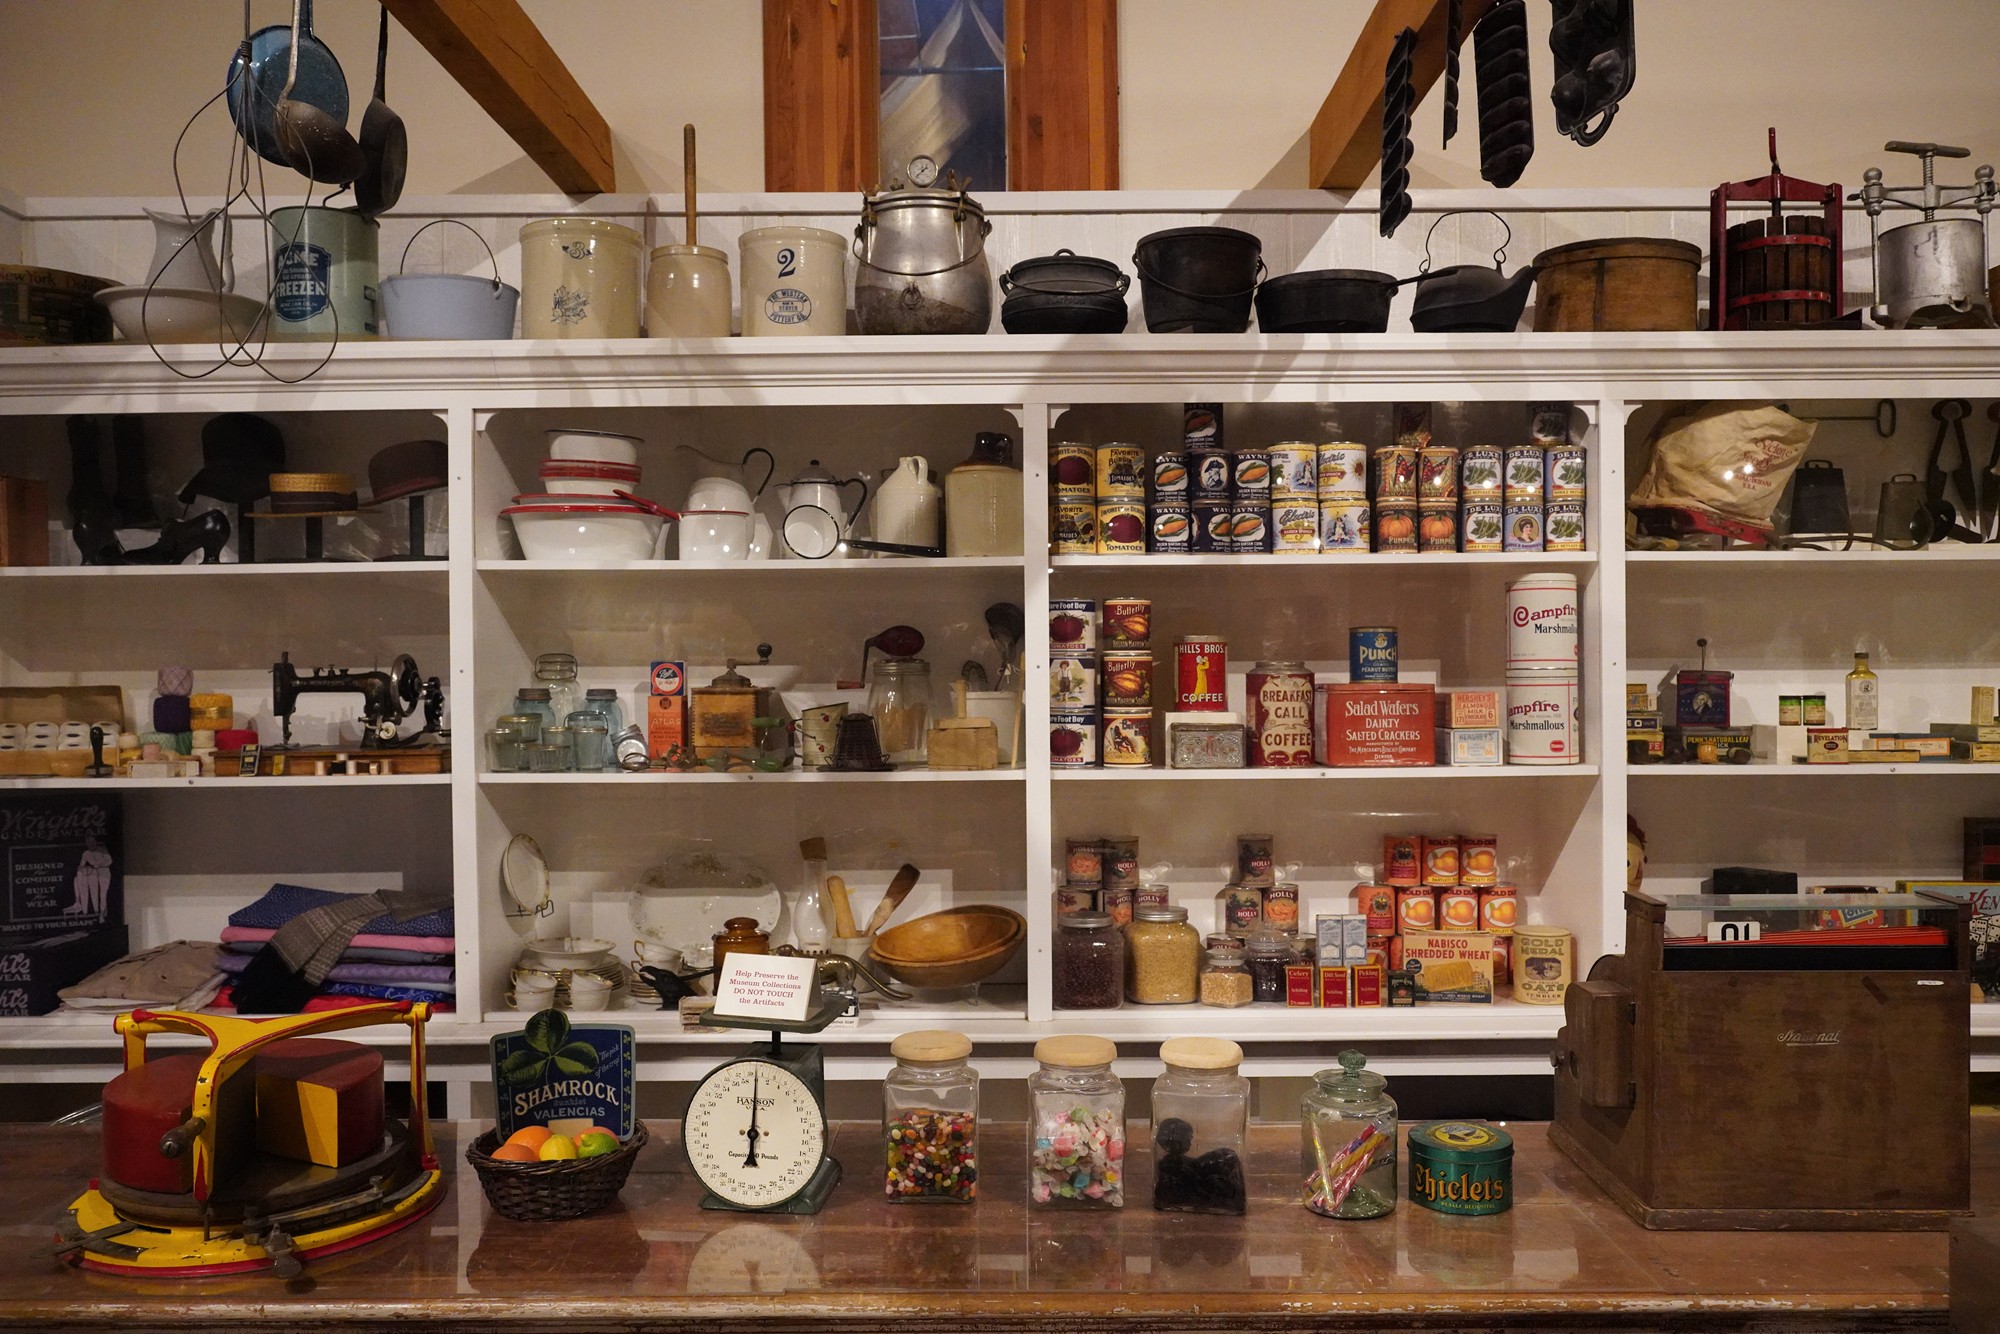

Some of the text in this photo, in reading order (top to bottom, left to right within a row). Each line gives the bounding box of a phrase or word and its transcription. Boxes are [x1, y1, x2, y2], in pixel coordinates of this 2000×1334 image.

[570, 241, 585, 259] 3
[777, 248, 797, 279] 2
[276, 281, 326, 298] FREEZER
[1557, 451, 1570, 459] DE
[1507, 506, 1520, 514] DE
[1279, 509, 1315, 526] Electric
[1106, 543, 1143, 552] TOMATOES
[1059, 602, 1087, 611] Foot Boy
[1116, 604, 1146, 616] Butterfly
[1179, 644, 1225, 654] HILLS BROS.
[1360, 645, 1397, 664] PUNCH
[1108, 660, 1136, 672] Butterfly
[1181, 693, 1223, 704] COFFEE
[1262, 689, 1312, 703] BREAKFAST
[1456, 694, 1492, 702] HERSHEY'S
[1274, 706, 1305, 719] CALL
[1345, 700, 1420, 718] Salad Wafers
[1057, 715, 1085, 724] Foot Boy
[1487, 710, 1494, 719] 6
[650, 718, 681, 728] ATLAS
[1366, 717, 1400, 729] DAINTY
[1509, 719, 1565, 731] Marshmallows
[1346, 728, 1421, 741] SALTED CRACKERS
[1459, 733, 1495, 741] HERSHEY'S
[1813, 734, 1848, 744] REVELATION
[1264, 733, 1312, 747] COFFEE
[15, 862, 65, 871] DESIGNED
[15, 875, 64, 884] COMFORT
[25, 886, 56, 895] BUILT
[1269, 891, 1295, 900] HOLLY
[26, 900, 58, 908] WEAR
[1138, 895, 1160, 903] HOLLY
[1237, 910, 1257, 918] HOLLY
[33, 922, 44, 930] TO
[44, 920, 68, 929] YOUR
[1427, 938, 1468, 949] NABISCO
[1521, 937, 1564, 948] GOLD
[1405, 948, 1491, 960] SHREDDED WHEAT
[1520, 946, 1565, 956] MEDAL
[735, 969, 752, 979] Help
[754, 971, 785, 980] Preserve
[1358, 969, 1378, 977] Pickling
[729, 978, 801, 990] Museum Collections
[1521, 983, 1565, 992] OATS
[752, 998, 785, 1007] Artifacts
[514, 1079, 620, 1116] SHAMROCK
[534, 1107, 606, 1120] VALENCIAS
[761, 1152, 779, 1160] Pounds
[1415, 1163, 1504, 1201] Chiclets
[1441, 1201, 1463, 1209] REALLY
